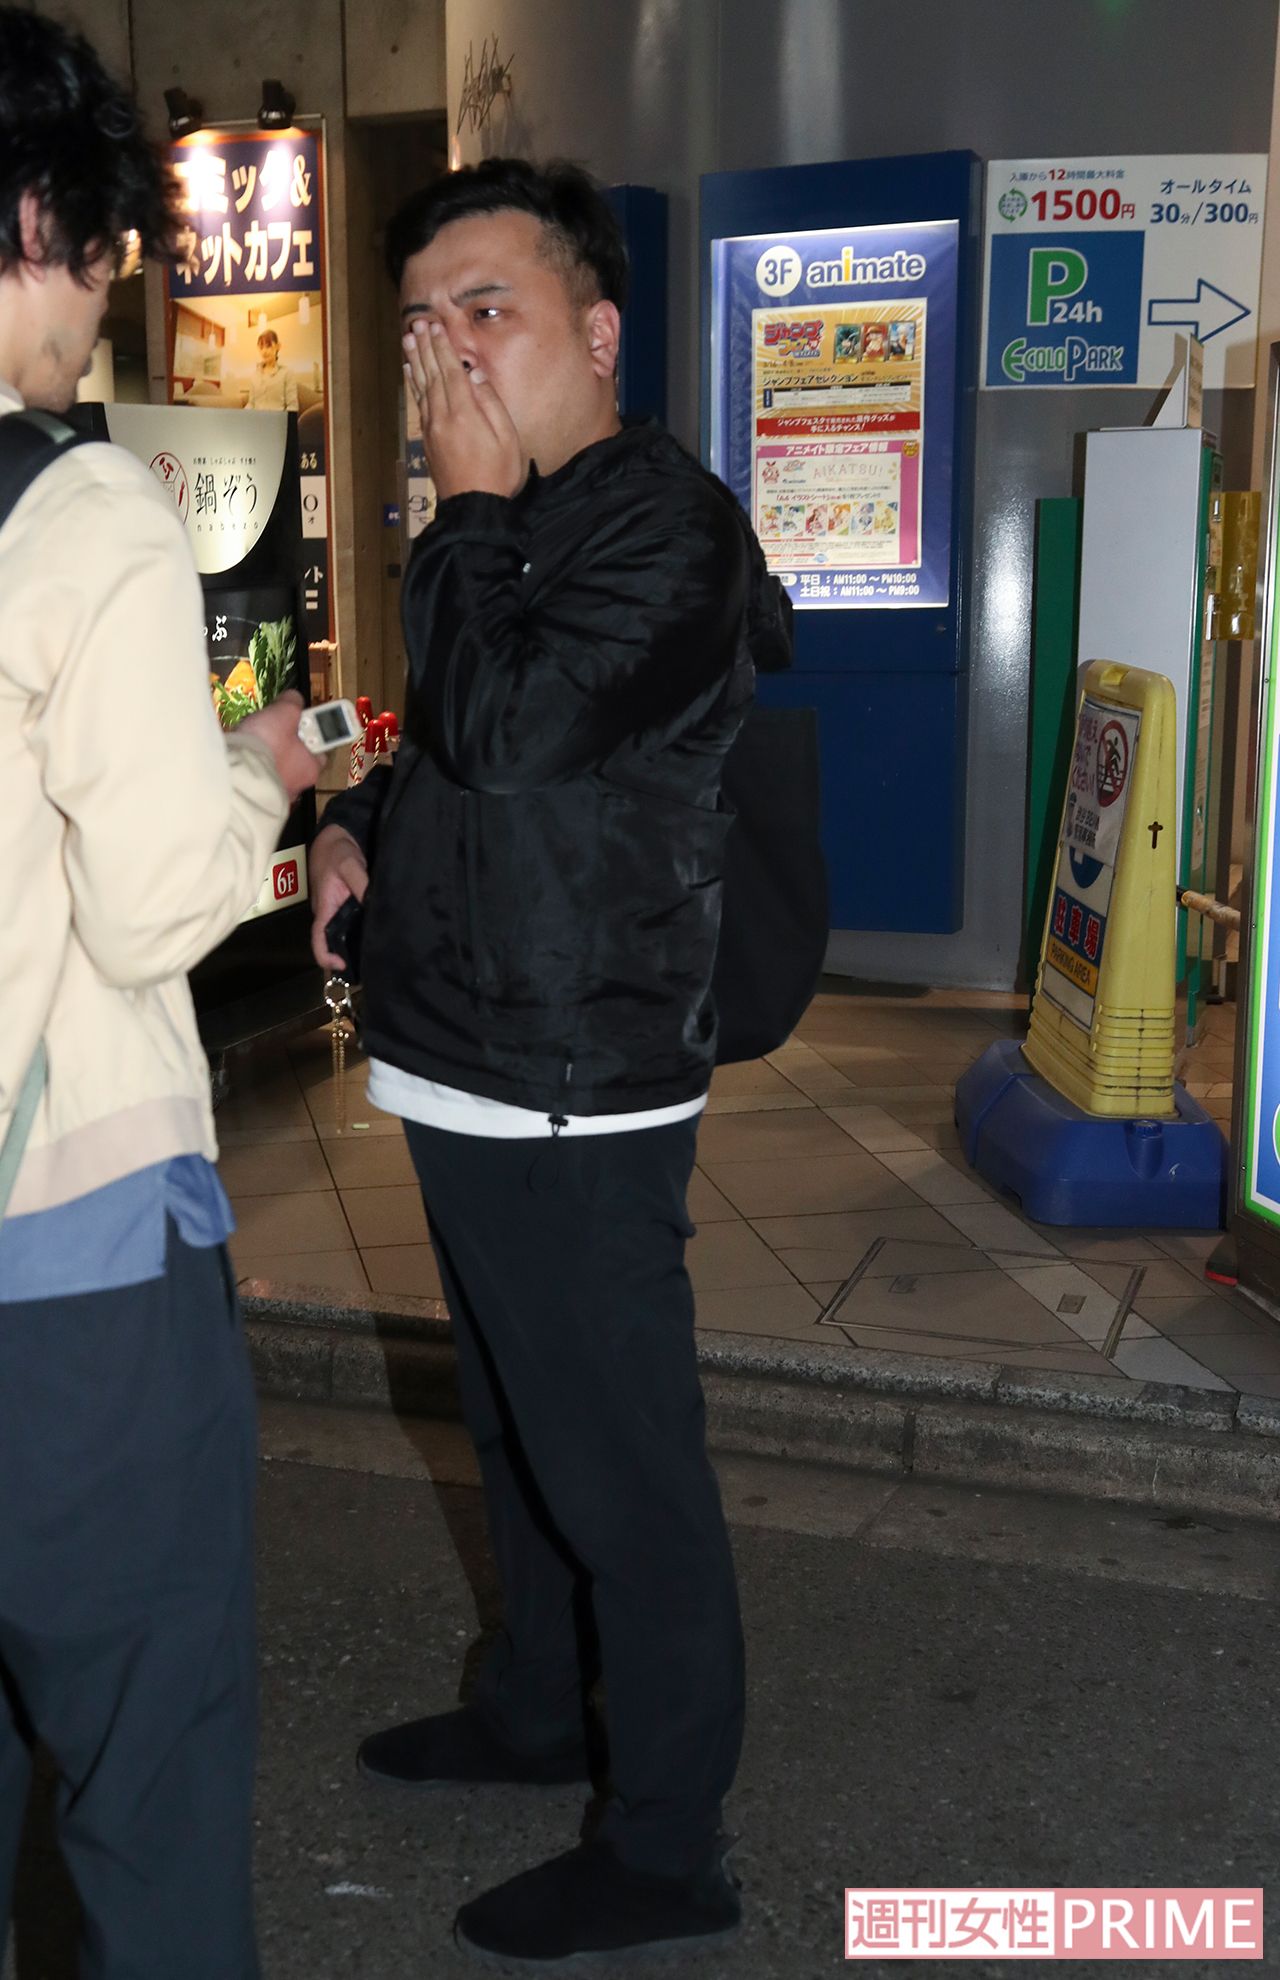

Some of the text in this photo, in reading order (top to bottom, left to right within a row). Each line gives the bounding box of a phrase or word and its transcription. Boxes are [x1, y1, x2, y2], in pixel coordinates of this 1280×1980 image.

[1160, 178, 1252, 195] オールタイム
[1031, 188, 1135, 221] 1500円
[1150, 202, 1259, 225] 30分/300円
[176, 219, 315, 286] ネットカフェ
[763, 247, 925, 287] 3F animate
[1027, 247, 1088, 326] P
[1052, 301, 1103, 324] 24h
[194, 472, 258, 516] 鍋ぞう
[800, 574, 820, 585] 平日
[833, 573, 867, 585] AM11:00
[881, 573, 916, 584] PM10:00
[840, 585, 874, 596] AM11:00
[277, 867, 295, 895] 6F
[1054, 895, 1101, 960] 駐車場
